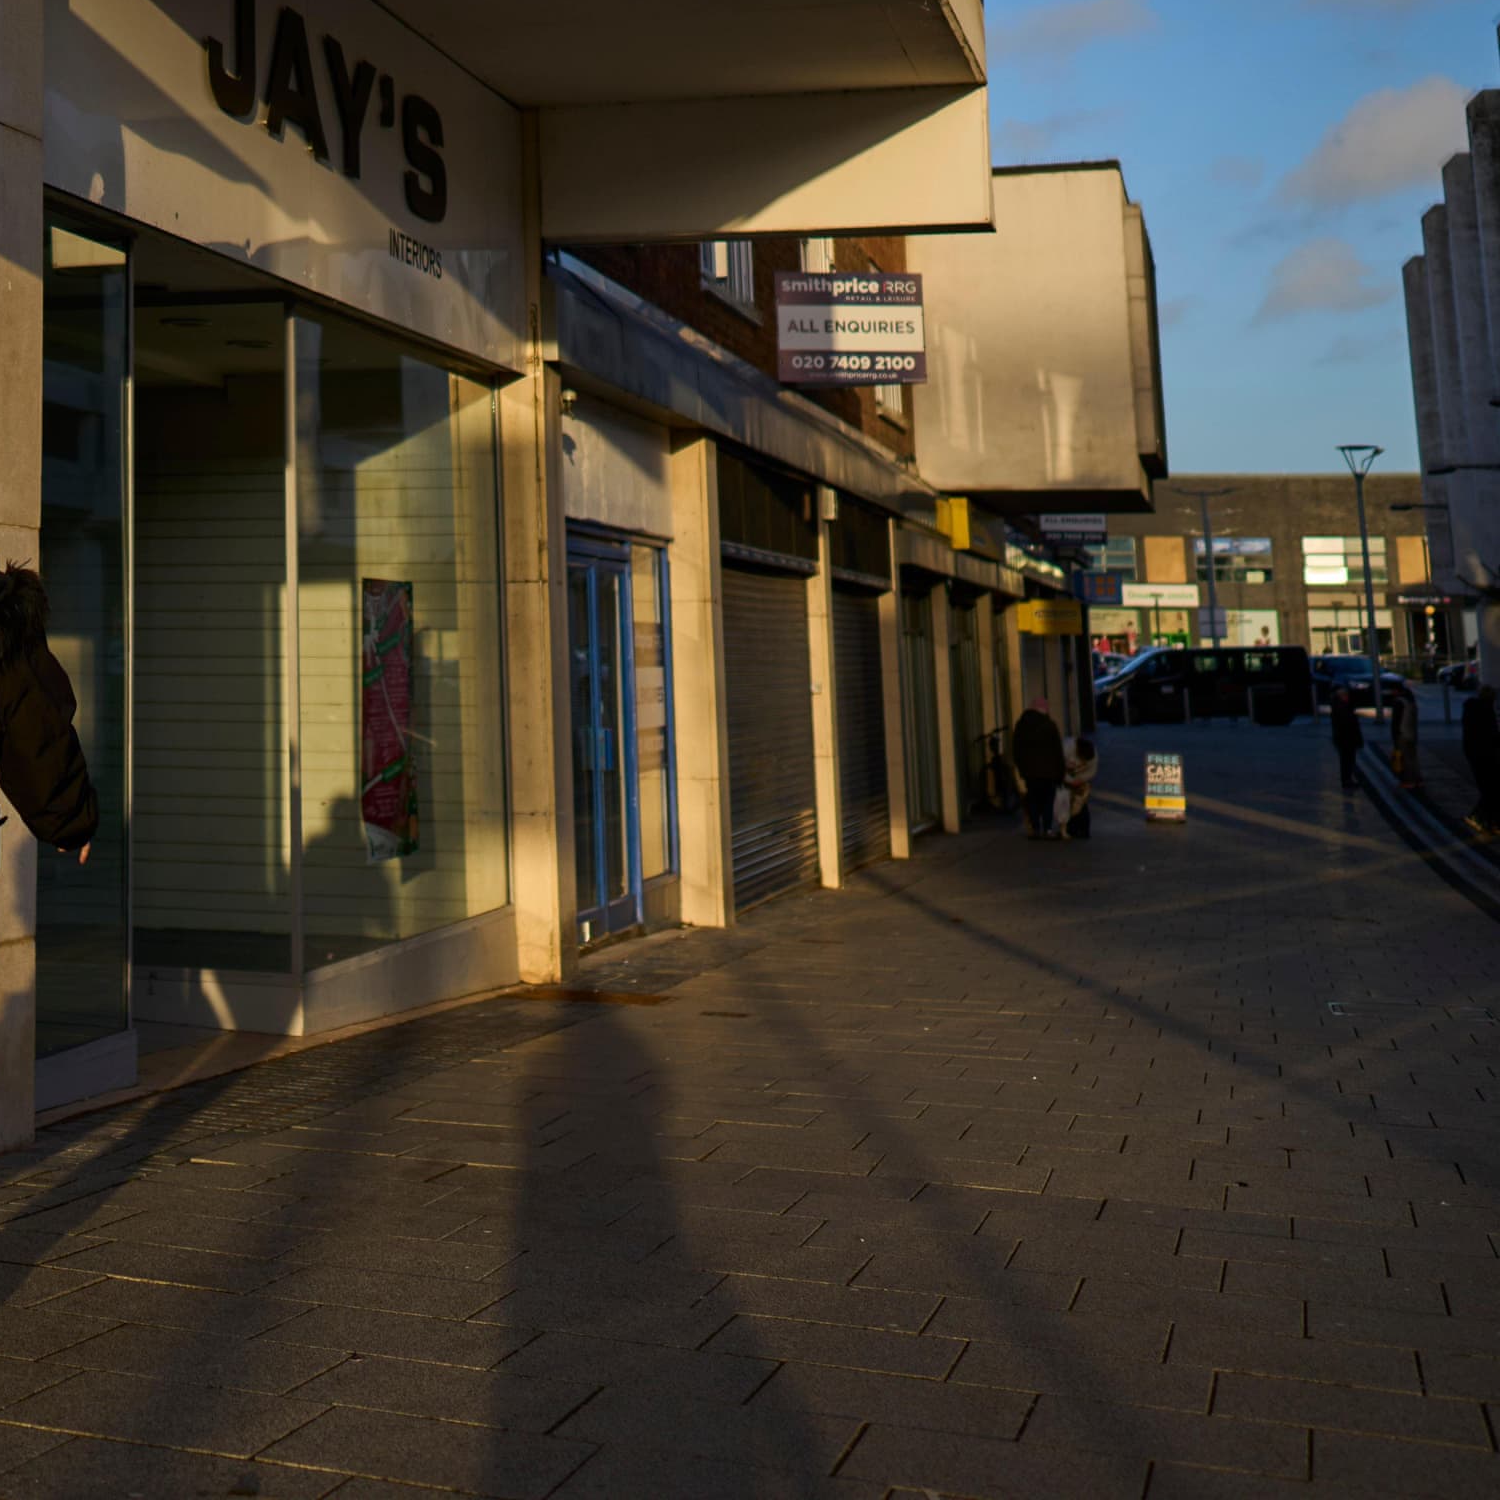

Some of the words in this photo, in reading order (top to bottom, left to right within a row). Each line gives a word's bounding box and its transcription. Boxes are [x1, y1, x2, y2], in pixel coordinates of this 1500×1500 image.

[389, 227, 442, 280] INTERIORS
[781, 277, 879, 297] smithprice
[787, 320, 819, 334] ALL
[824, 320, 916, 335] ENQUIRIES
[792, 355, 825, 369] 020
[829, 356, 871, 370] 7409
[875, 356, 915, 371] 2100
